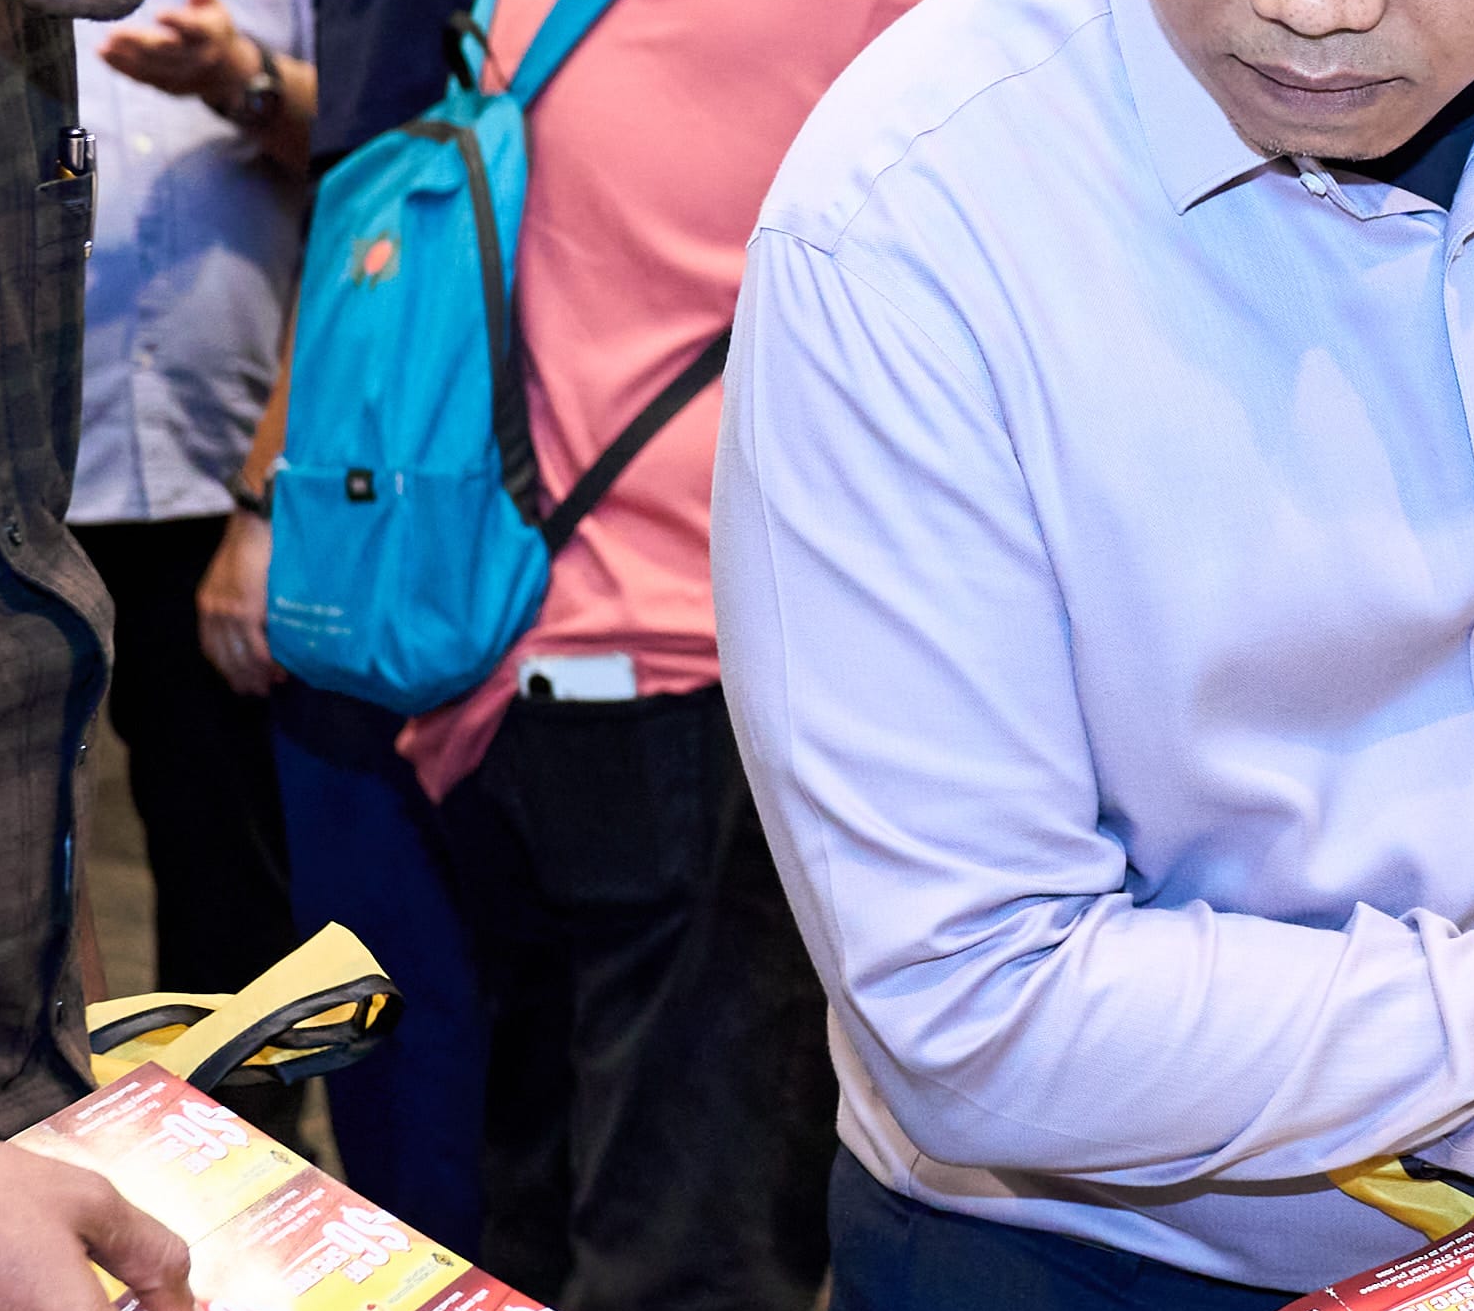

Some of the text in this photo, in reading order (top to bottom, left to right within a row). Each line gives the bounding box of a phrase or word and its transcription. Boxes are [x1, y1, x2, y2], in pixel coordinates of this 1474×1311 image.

[322, 1205, 412, 1266] $6
[1394, 1254, 1429, 1271] February
[1407, 1263, 1430, 1277] fuel
[1444, 1256, 1462, 1269] AA
[1359, 1271, 1408, 1295] purchase
[1396, 1265, 1446, 1289] Members
